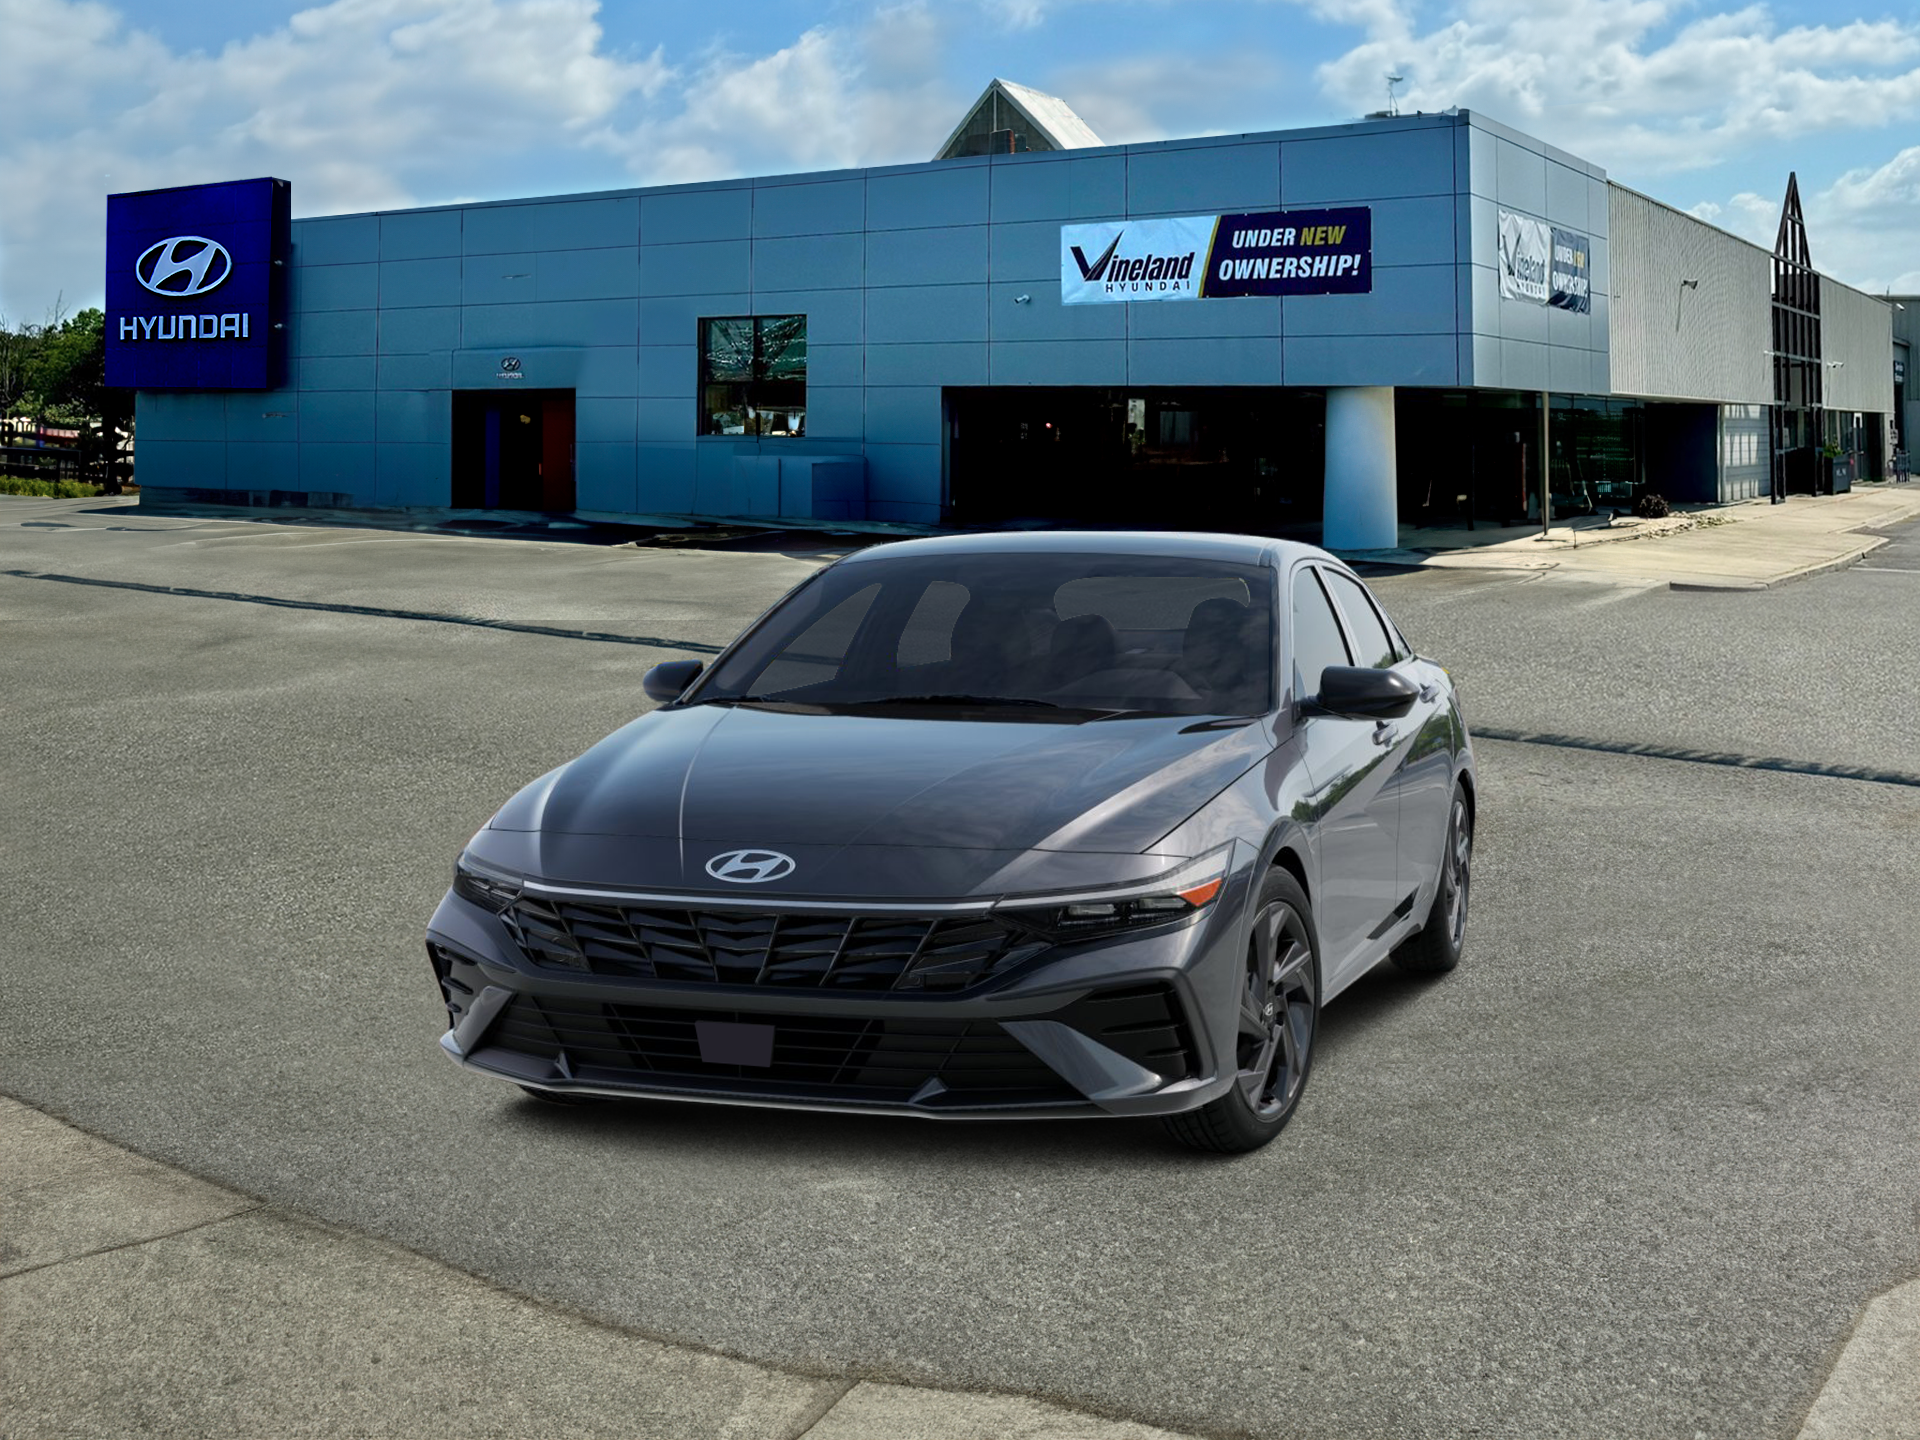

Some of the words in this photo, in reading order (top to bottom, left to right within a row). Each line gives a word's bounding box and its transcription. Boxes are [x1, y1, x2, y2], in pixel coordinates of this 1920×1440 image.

[1232, 229, 1295, 248] UNDER
[1300, 226, 1346, 246] NEW
[1070, 229, 1195, 282] Vineland
[1219, 254, 1361, 280] OWNERSHIP!
[1105, 281, 1190, 293] HYUNDAI
[119, 313, 249, 340] HYUNDAI
